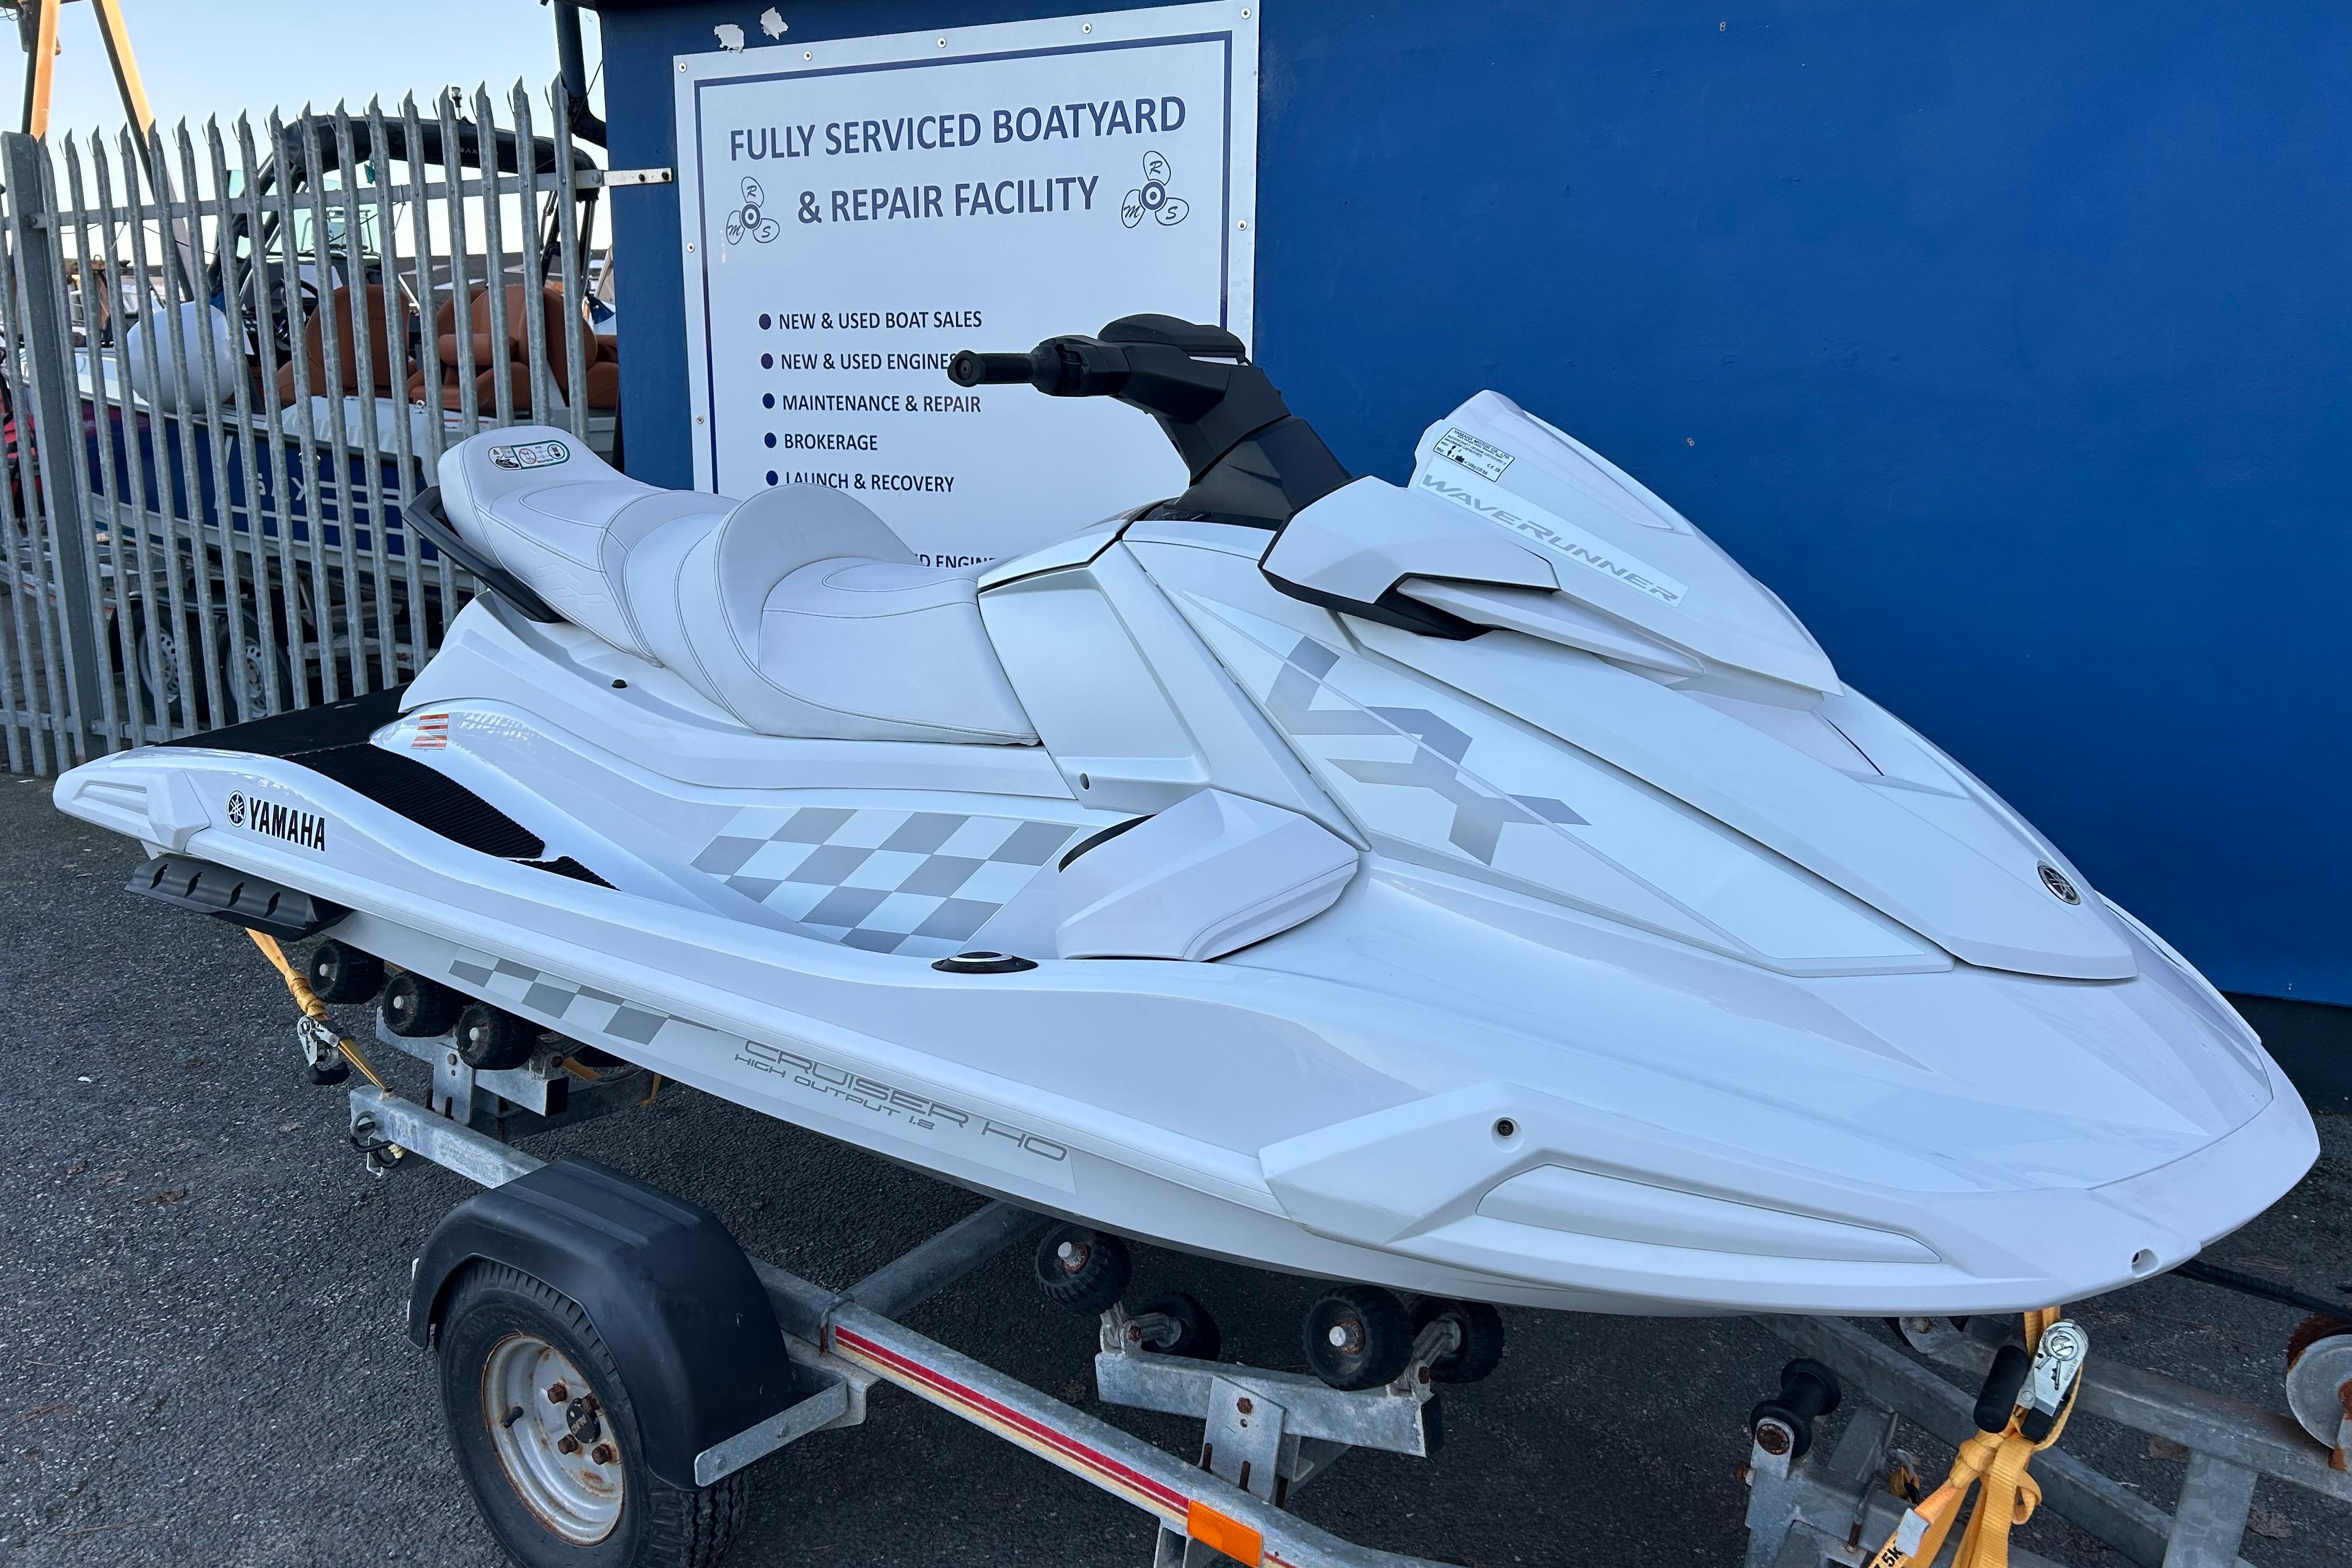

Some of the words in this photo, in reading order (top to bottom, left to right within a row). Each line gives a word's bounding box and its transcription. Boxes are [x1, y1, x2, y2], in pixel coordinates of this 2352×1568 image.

[730, 124, 816, 161] FULLY
[825, 113, 981, 155] SERVICED
[993, 96, 1185, 144] BOATYARD
[1149, 160, 1163, 175] R
[746, 185, 757, 198] R
[798, 191, 822, 223] &
[831, 185, 944, 222] REPAIR
[955, 176, 1099, 216] FACILITY
[1166, 206, 1178, 219] S
[761, 226, 771, 238] S
[779, 313, 816, 330] NEW
[821, 313, 834, 330] &
[838, 313, 880, 328] USED
[886, 312, 929, 328] BOAT
[933, 311, 982, 327] SALES
[781, 354, 818, 369] NEW
[823, 353, 835, 369] &
[840, 354, 882, 369] USED
[783, 395, 900, 411] MAINTENANCE
[905, 395, 918, 411] &
[923, 396, 981, 412] REPAIR
[785, 433, 878, 450] BROKERAGE
[1454, 429, 1474, 442] YAMAHA
[853, 473, 866, 489] &
[872, 474, 954, 492] RECOVERY
[1422, 473, 1679, 603] WAVERUNNER
[250, 797, 326, 852] YAMAHA
[734, 1053, 786, 1079] HIGH
[793, 1075, 901, 1117] OUTPUT
[908, 1115, 936, 1130] 1.8
[744, 1040, 969, 1128] CRUISER
[982, 1121, 1068, 1161] HO
